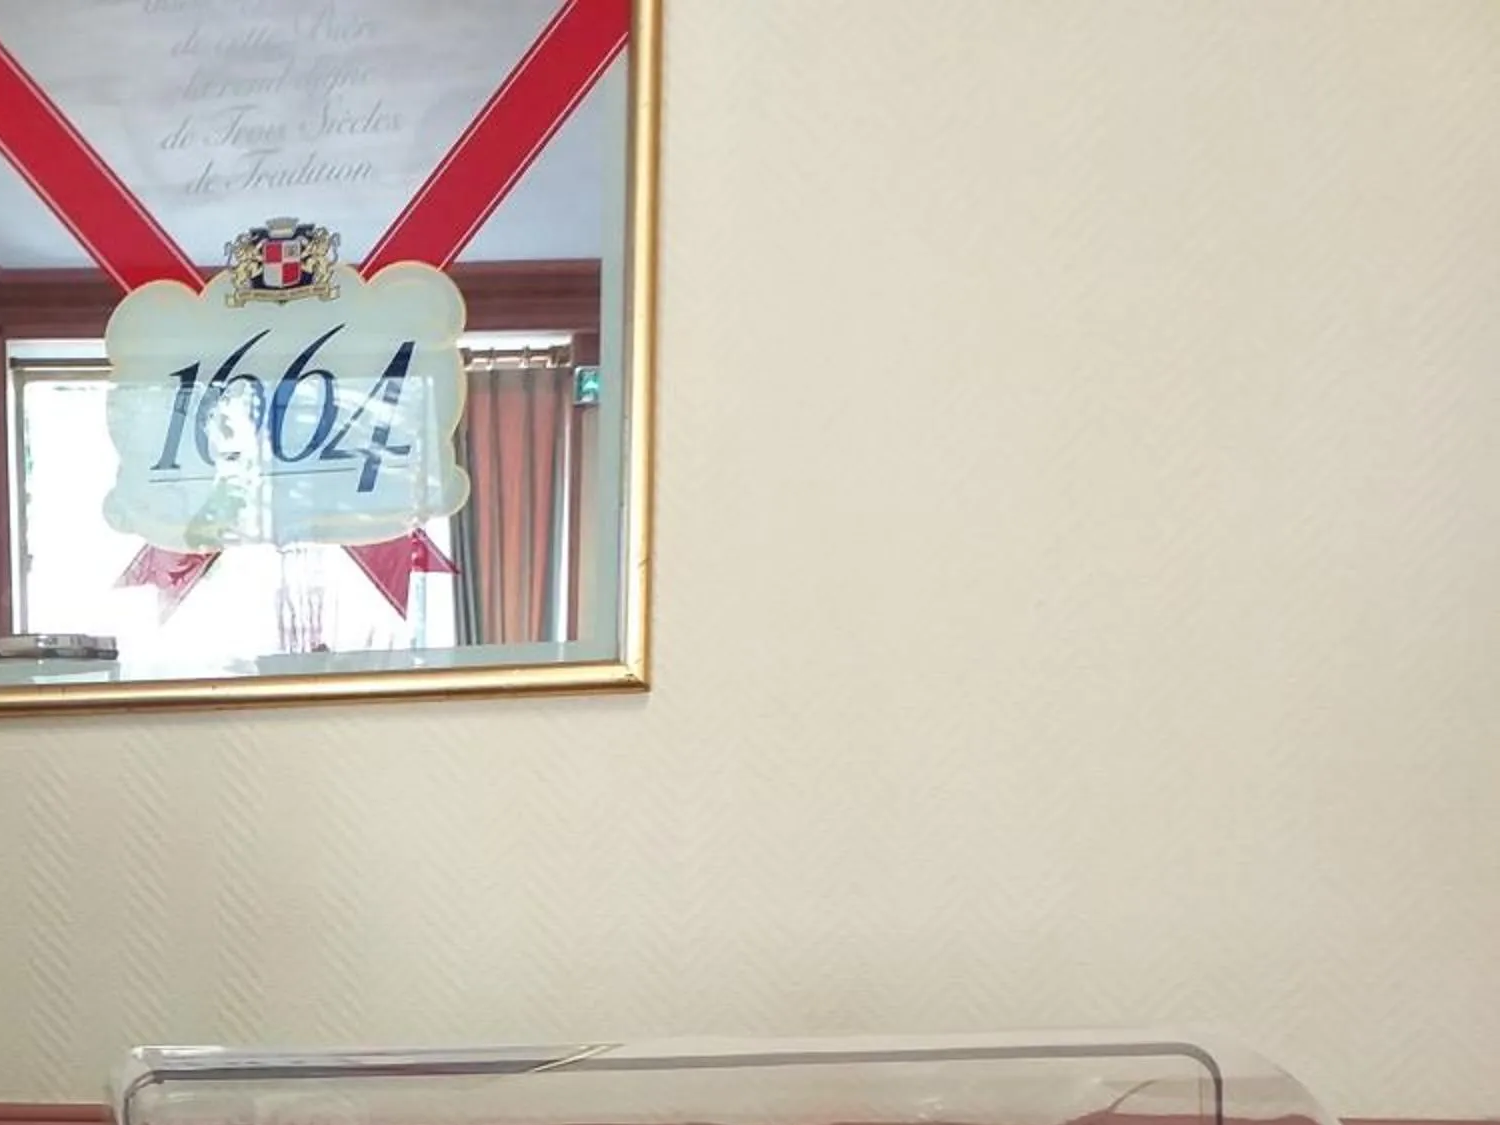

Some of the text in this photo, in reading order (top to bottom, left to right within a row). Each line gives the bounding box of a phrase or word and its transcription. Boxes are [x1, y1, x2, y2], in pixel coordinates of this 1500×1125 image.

[160, 114, 192, 151] de
[186, 146, 373, 195] de Tradition
[149, 322, 417, 494] 1664
